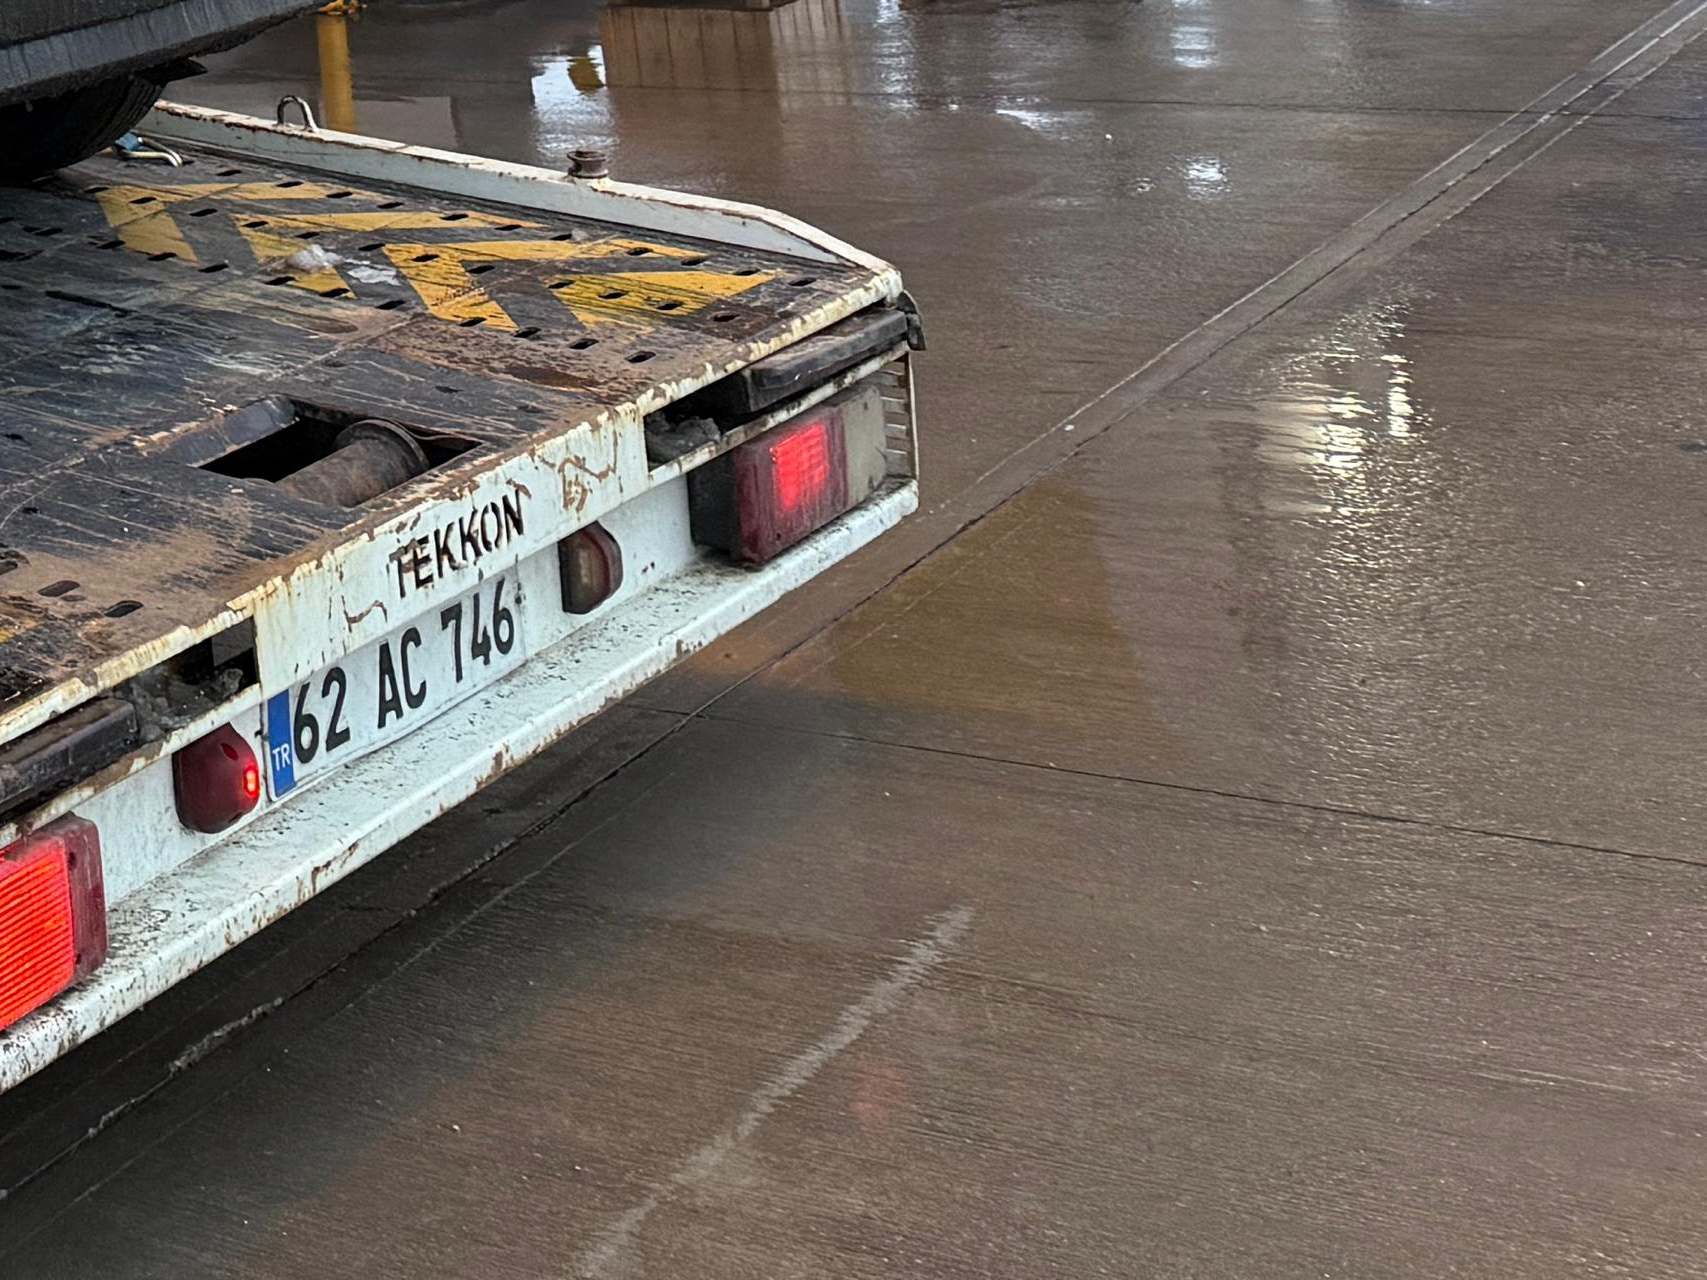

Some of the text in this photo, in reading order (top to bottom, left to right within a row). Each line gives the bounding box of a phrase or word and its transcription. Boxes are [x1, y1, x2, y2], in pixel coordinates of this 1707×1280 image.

[388, 488, 526, 599] TEKKON
[292, 577, 515, 764] 62 AC 746
[271, 742, 293, 772] TR
